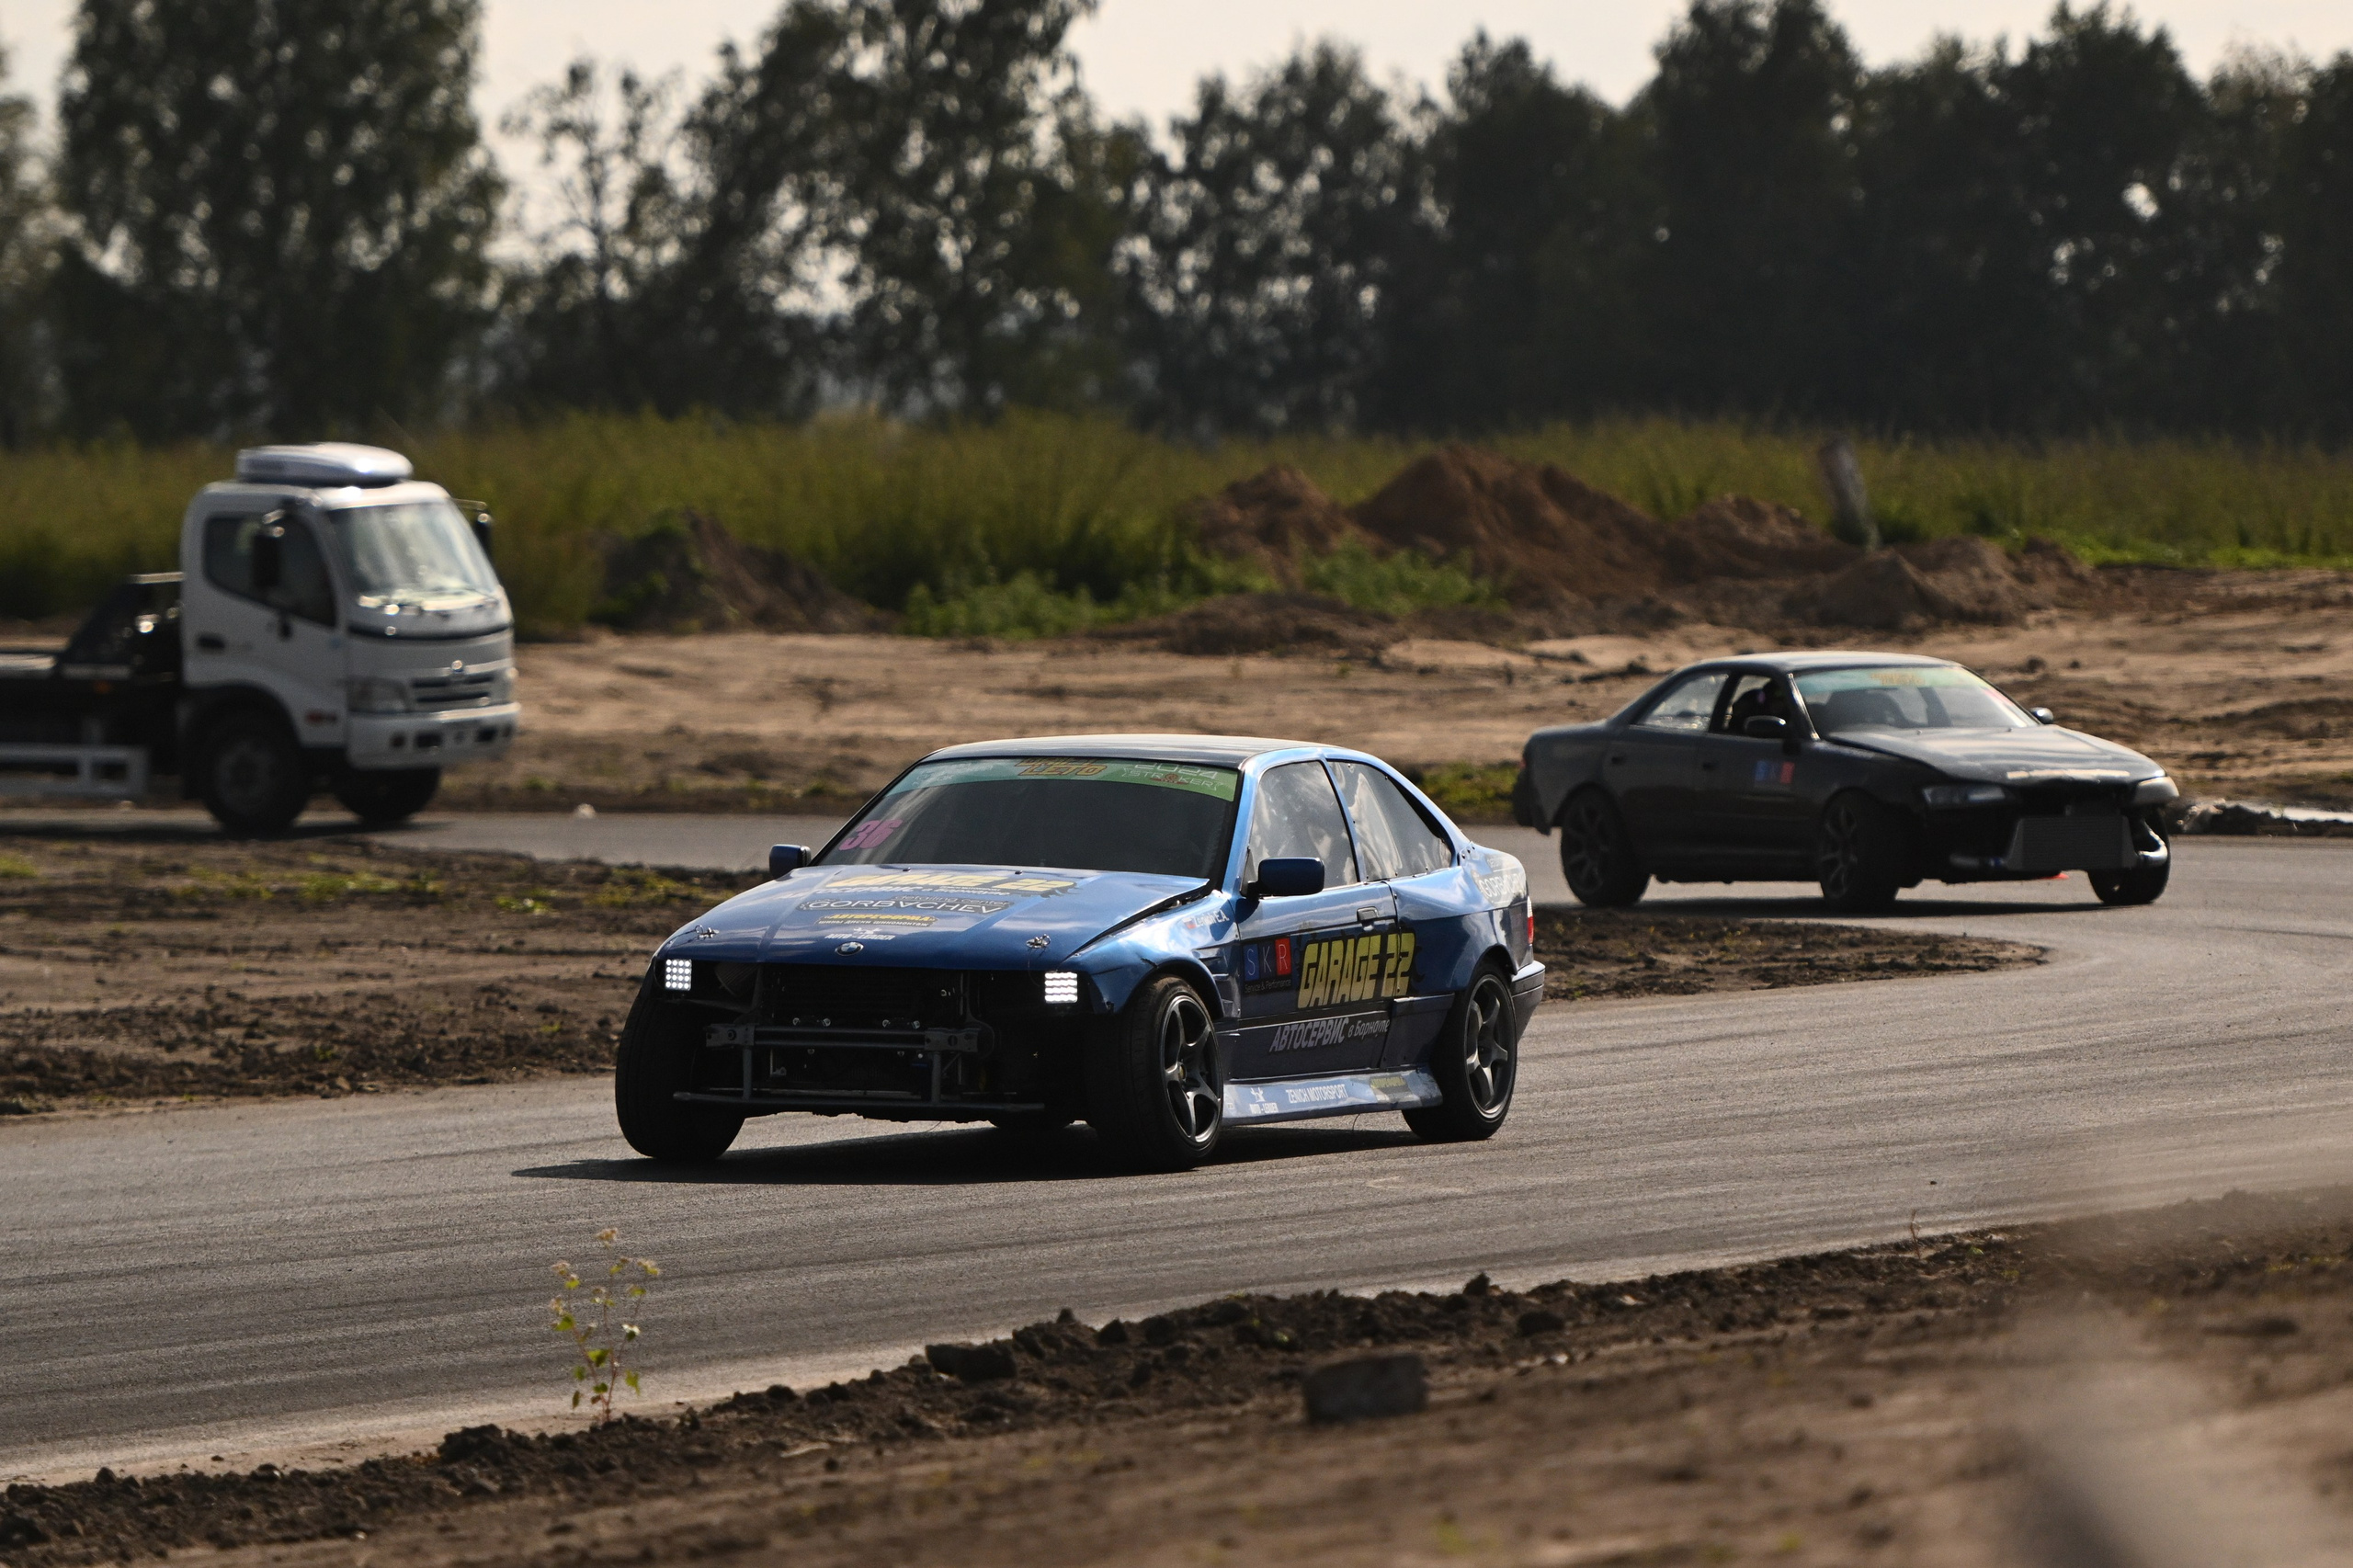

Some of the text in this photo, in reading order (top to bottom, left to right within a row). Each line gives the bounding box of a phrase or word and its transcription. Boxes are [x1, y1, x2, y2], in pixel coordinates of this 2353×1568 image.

[1018, 764, 1108, 777] LETO
[838, 819, 904, 851] 36
[993, 878, 1074, 892] 22
[1298, 932, 1415, 1009] GARAGE 22
[1269, 1017, 1349, 1052] АВТОСЕРВИС
[1309, 1084, 1348, 1102] MOTORSPORT
